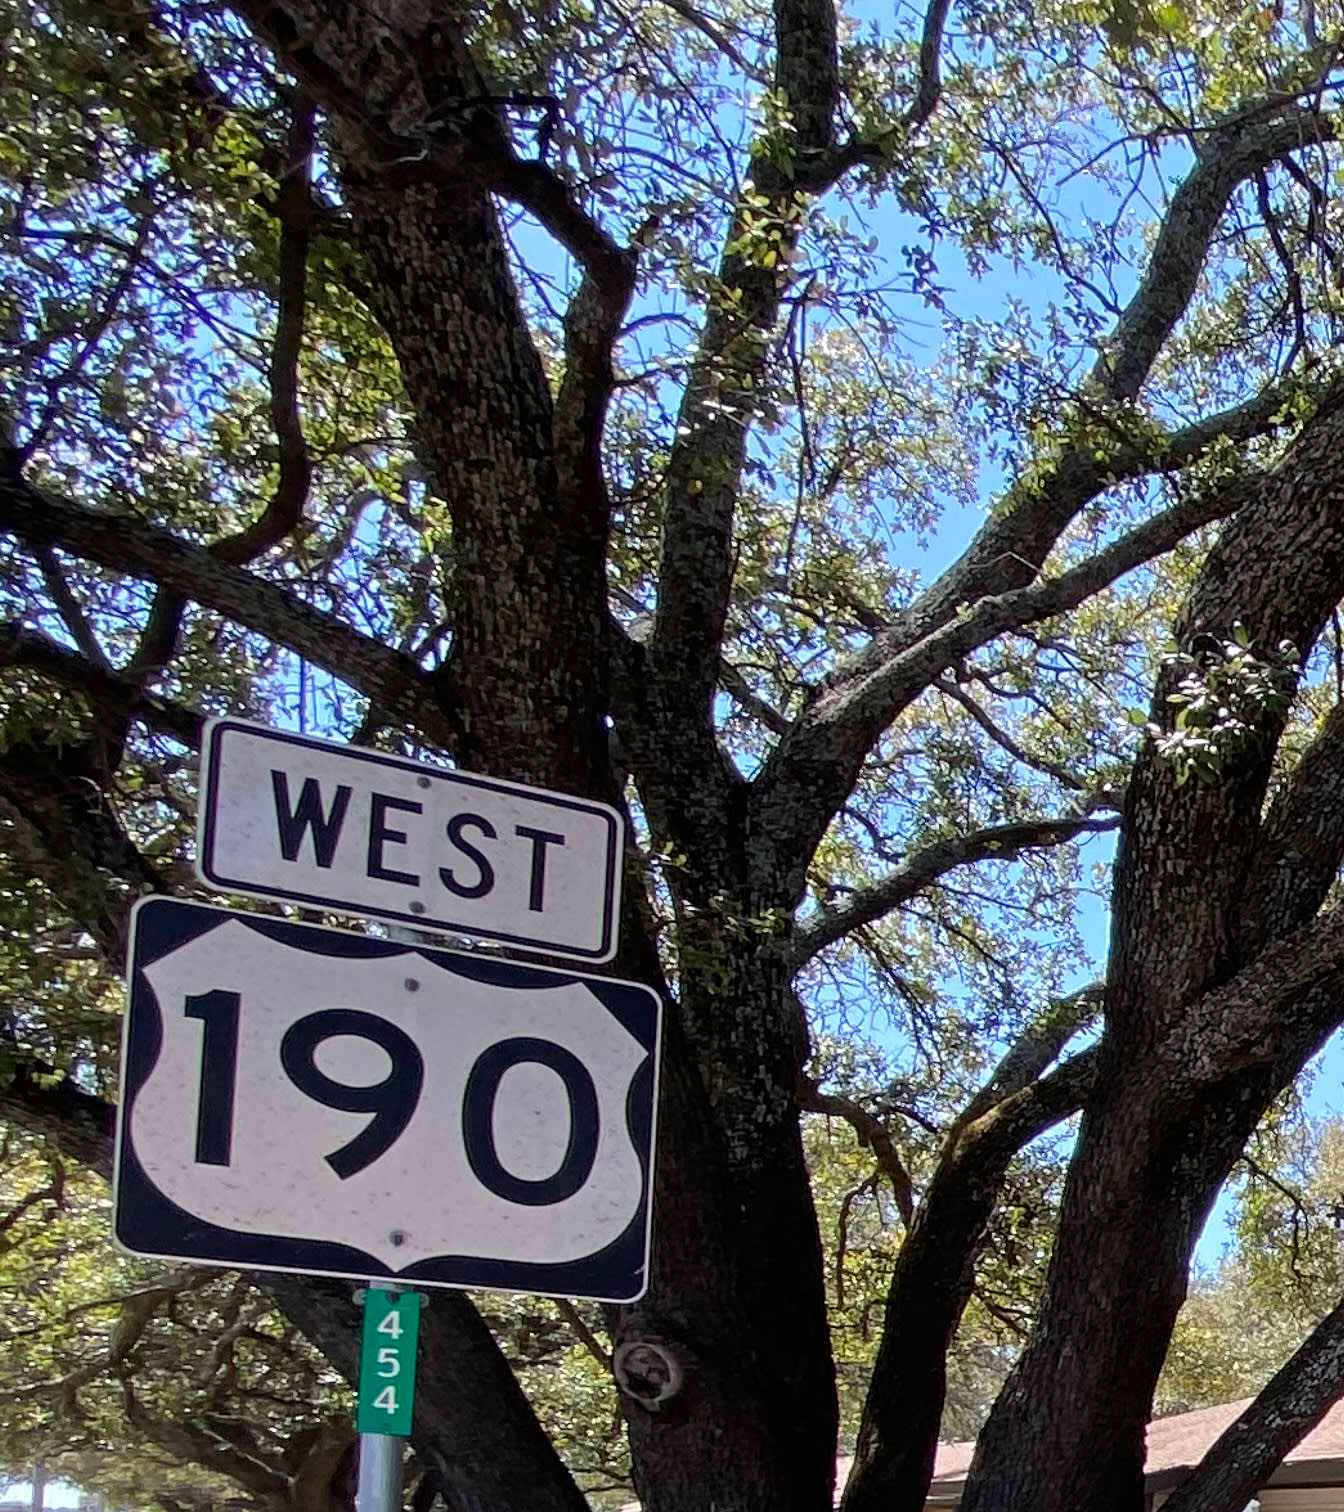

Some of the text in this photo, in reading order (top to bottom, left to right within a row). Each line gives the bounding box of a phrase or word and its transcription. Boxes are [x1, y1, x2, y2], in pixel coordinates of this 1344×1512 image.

[270, 768, 566, 913] WEST
[183, 988, 601, 1207] 190
[372, 1310, 405, 1415] 454
